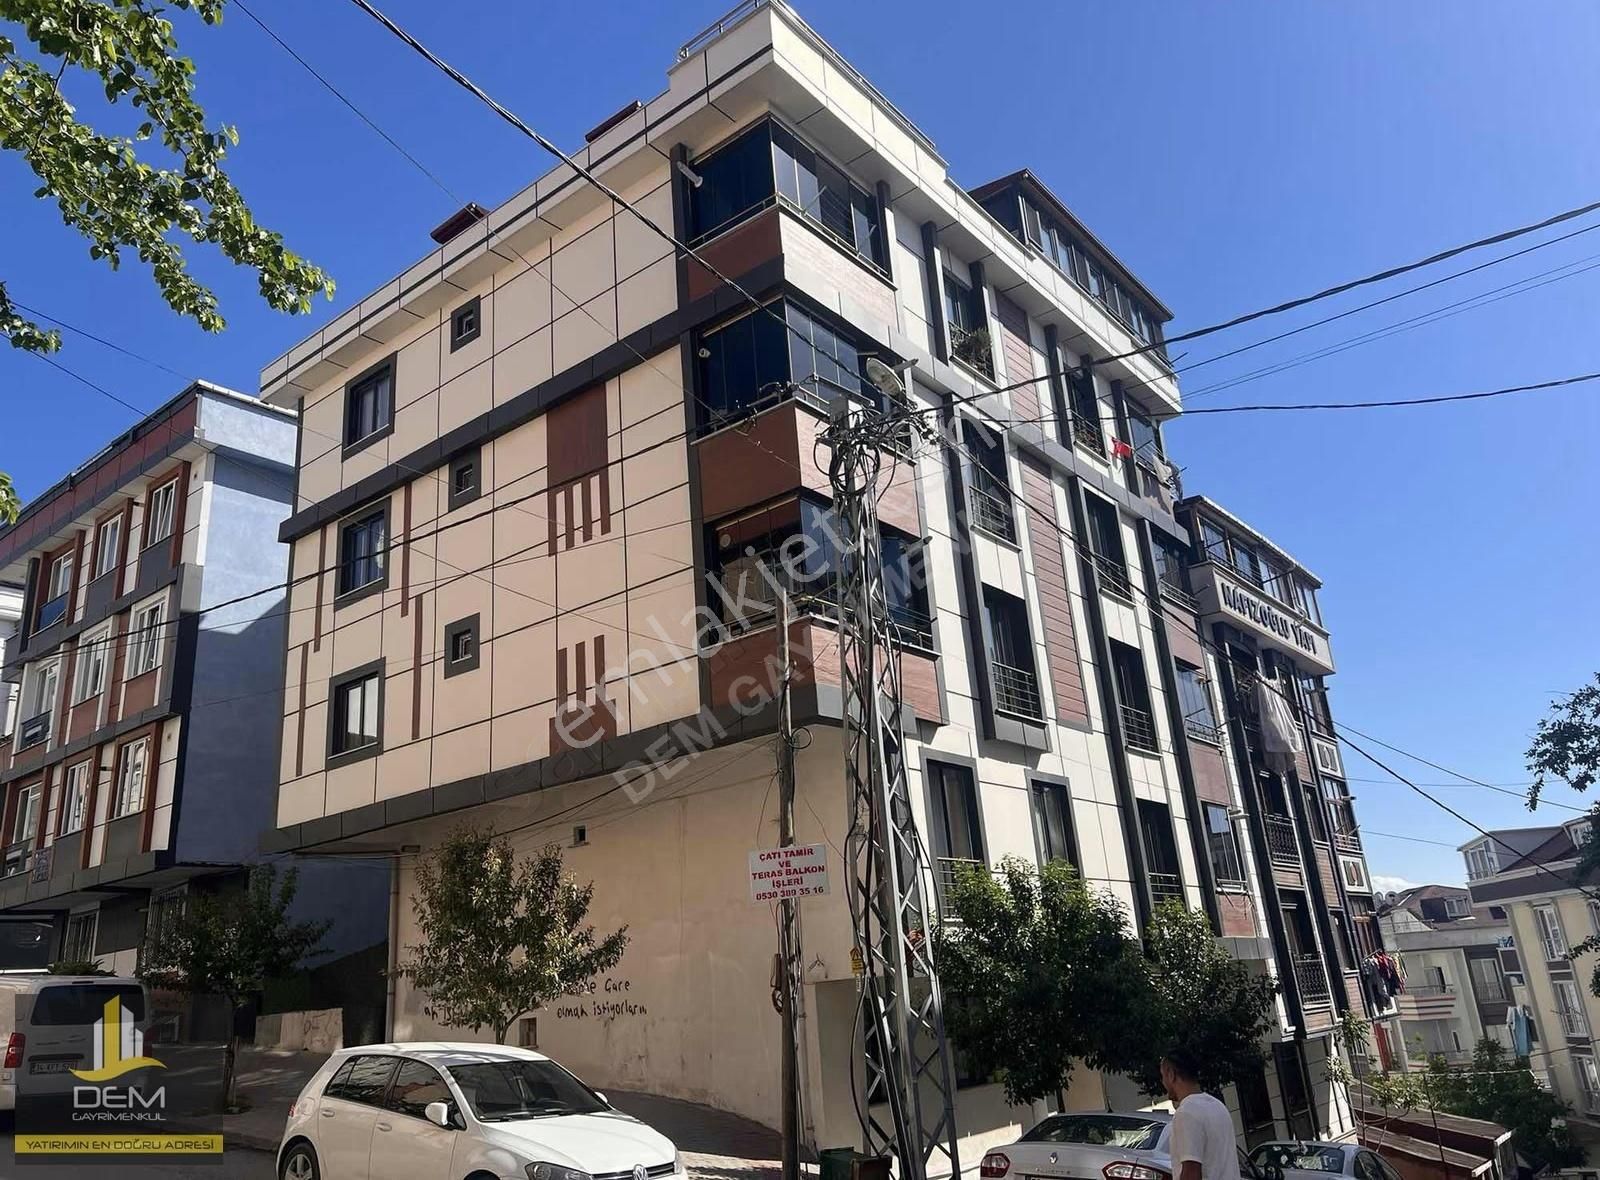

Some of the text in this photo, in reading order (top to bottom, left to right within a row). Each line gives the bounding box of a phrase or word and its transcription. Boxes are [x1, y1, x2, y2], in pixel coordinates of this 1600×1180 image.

[783, 847, 814, 858] TAMİR
[778, 860, 791, 868] VE
[752, 865, 825, 880] TERAS BALKON
[756, 890, 778, 901] 0530
[799, 887, 810, 896] 35
[813, 886, 824, 894] 16
